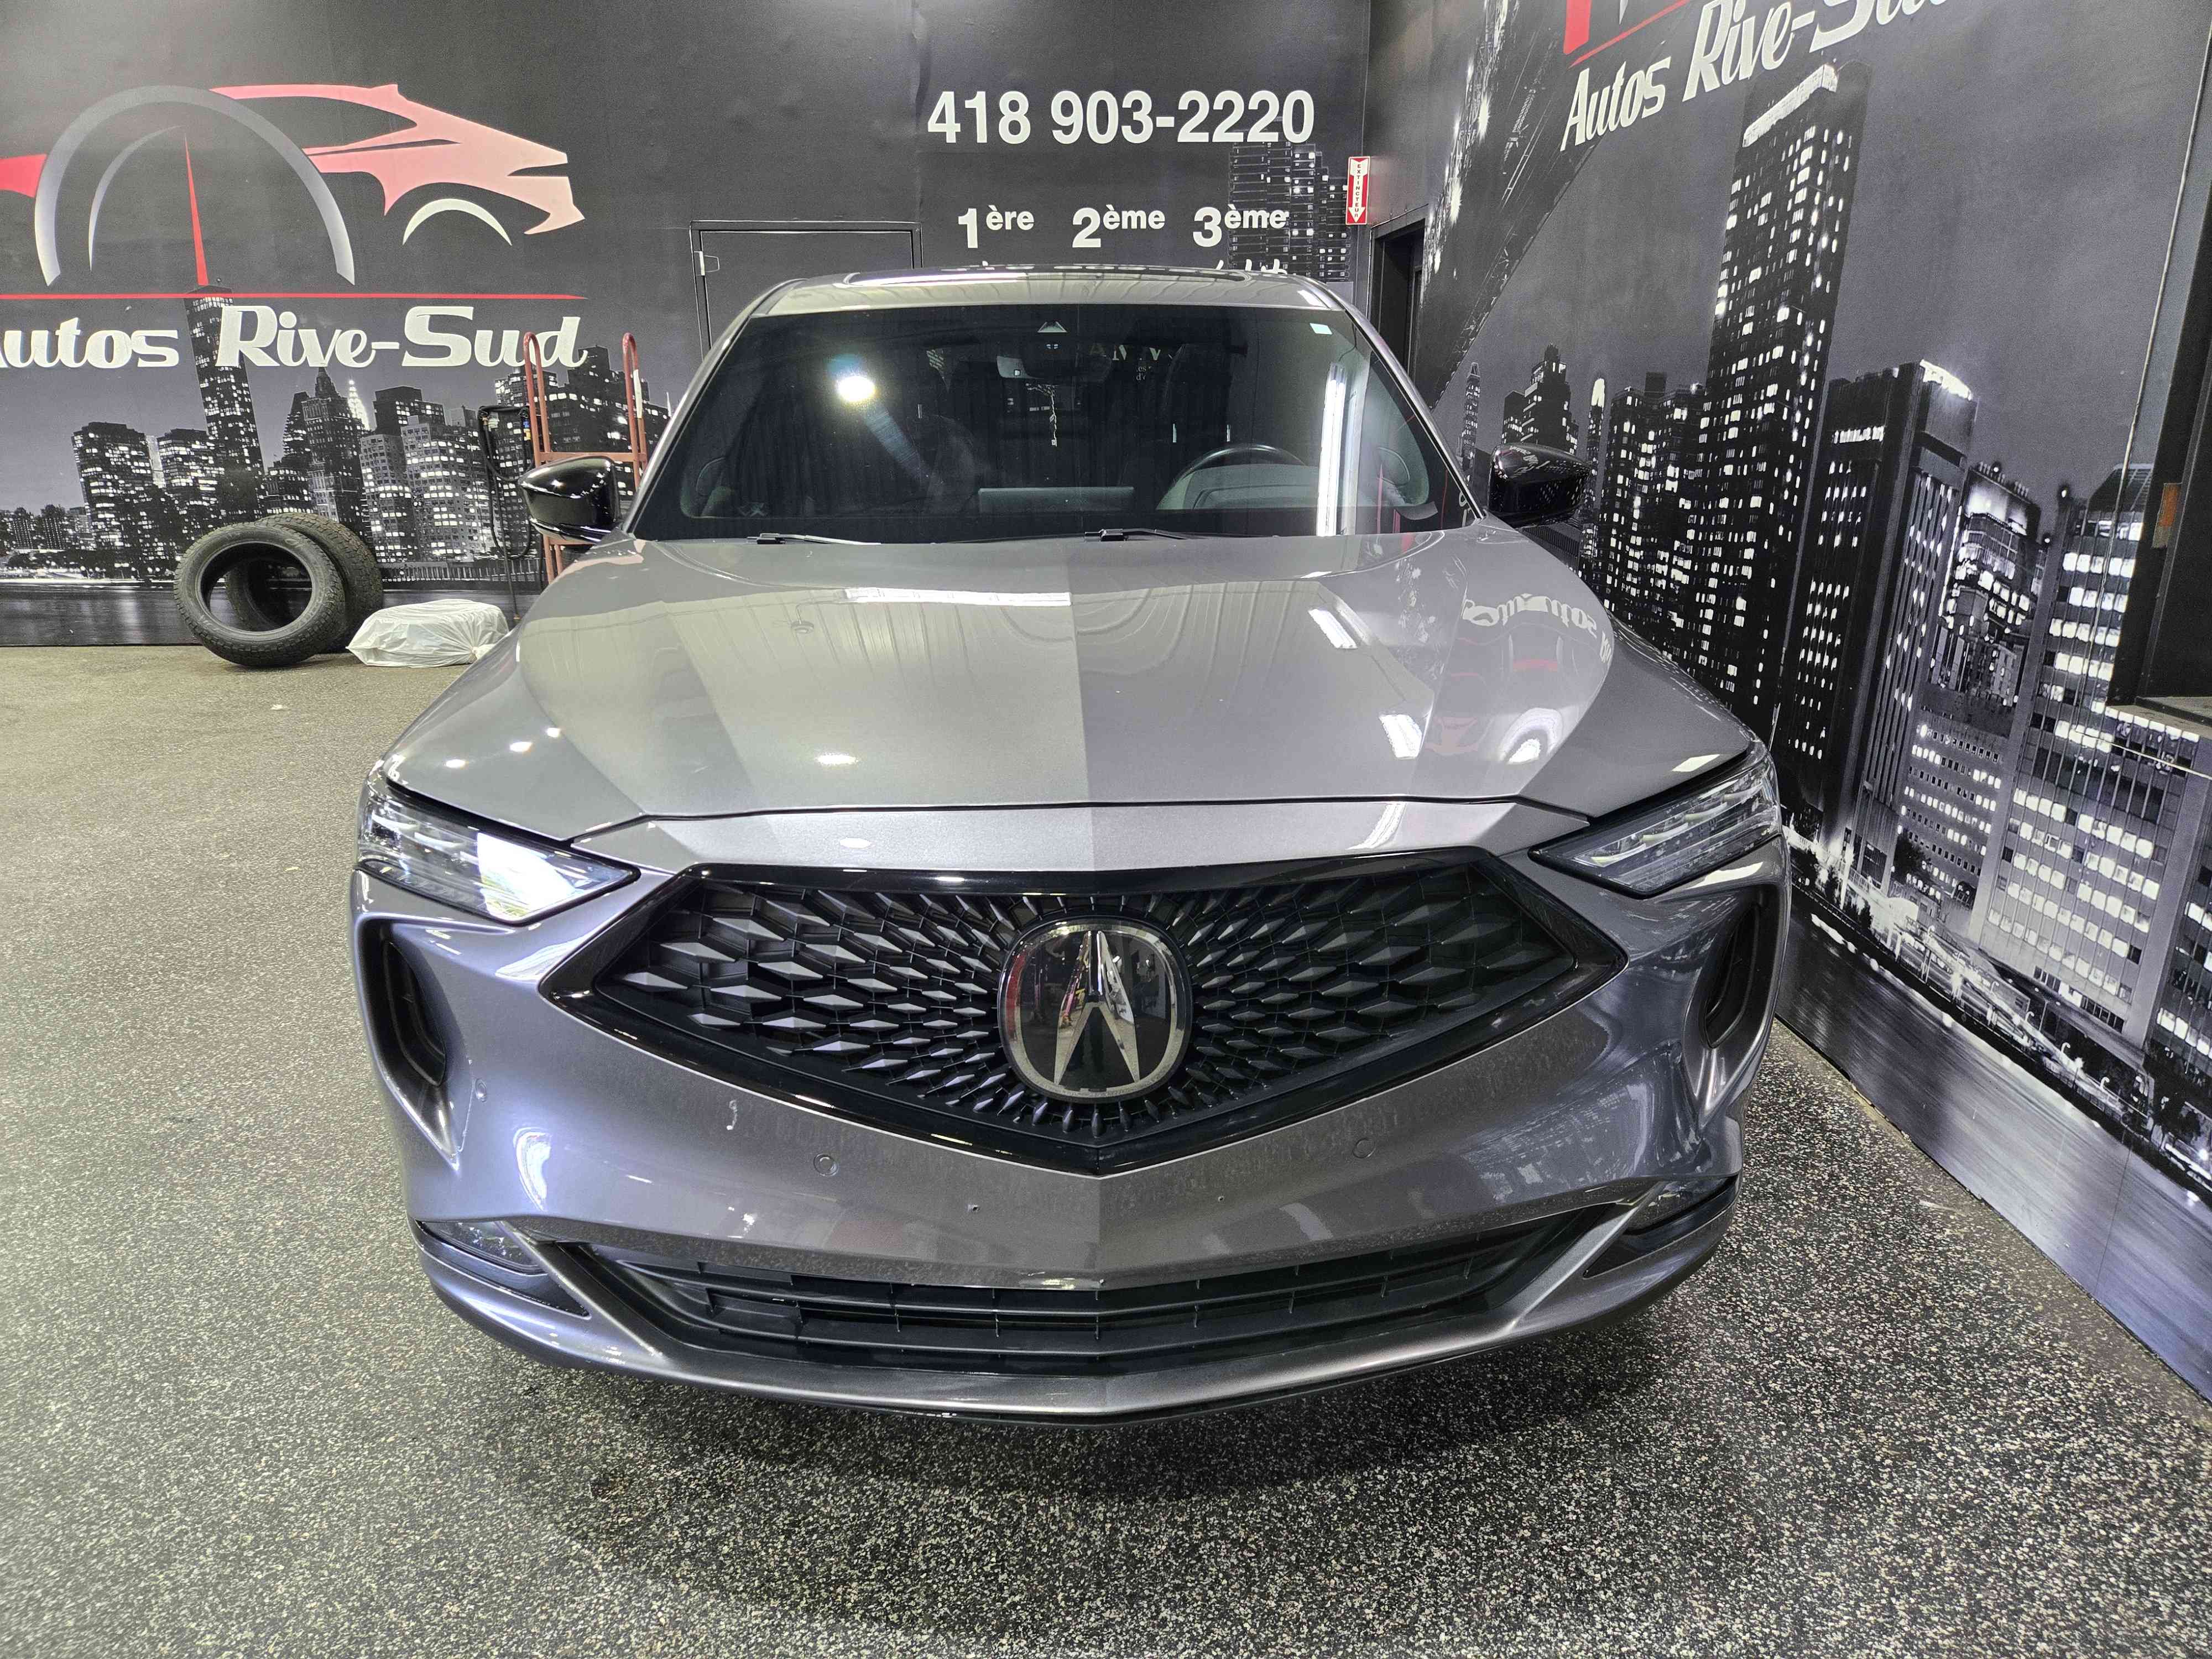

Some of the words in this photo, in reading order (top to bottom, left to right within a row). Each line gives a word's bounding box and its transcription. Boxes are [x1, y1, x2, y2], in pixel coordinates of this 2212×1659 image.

[1559, 56, 1672, 152] Autos
[1682, 0, 1947, 102] Rive-
[927, 90, 1031, 144] 418
[1051, 90, 1315, 144] 903-2220
[958, 204, 1035, 248] 1ère
[1072, 204, 1166, 248] 2ème
[1193, 204, 1290, 247] 3ème
[0, 317, 180, 369] utos
[215, 304, 588, 368] Rive-Sud
